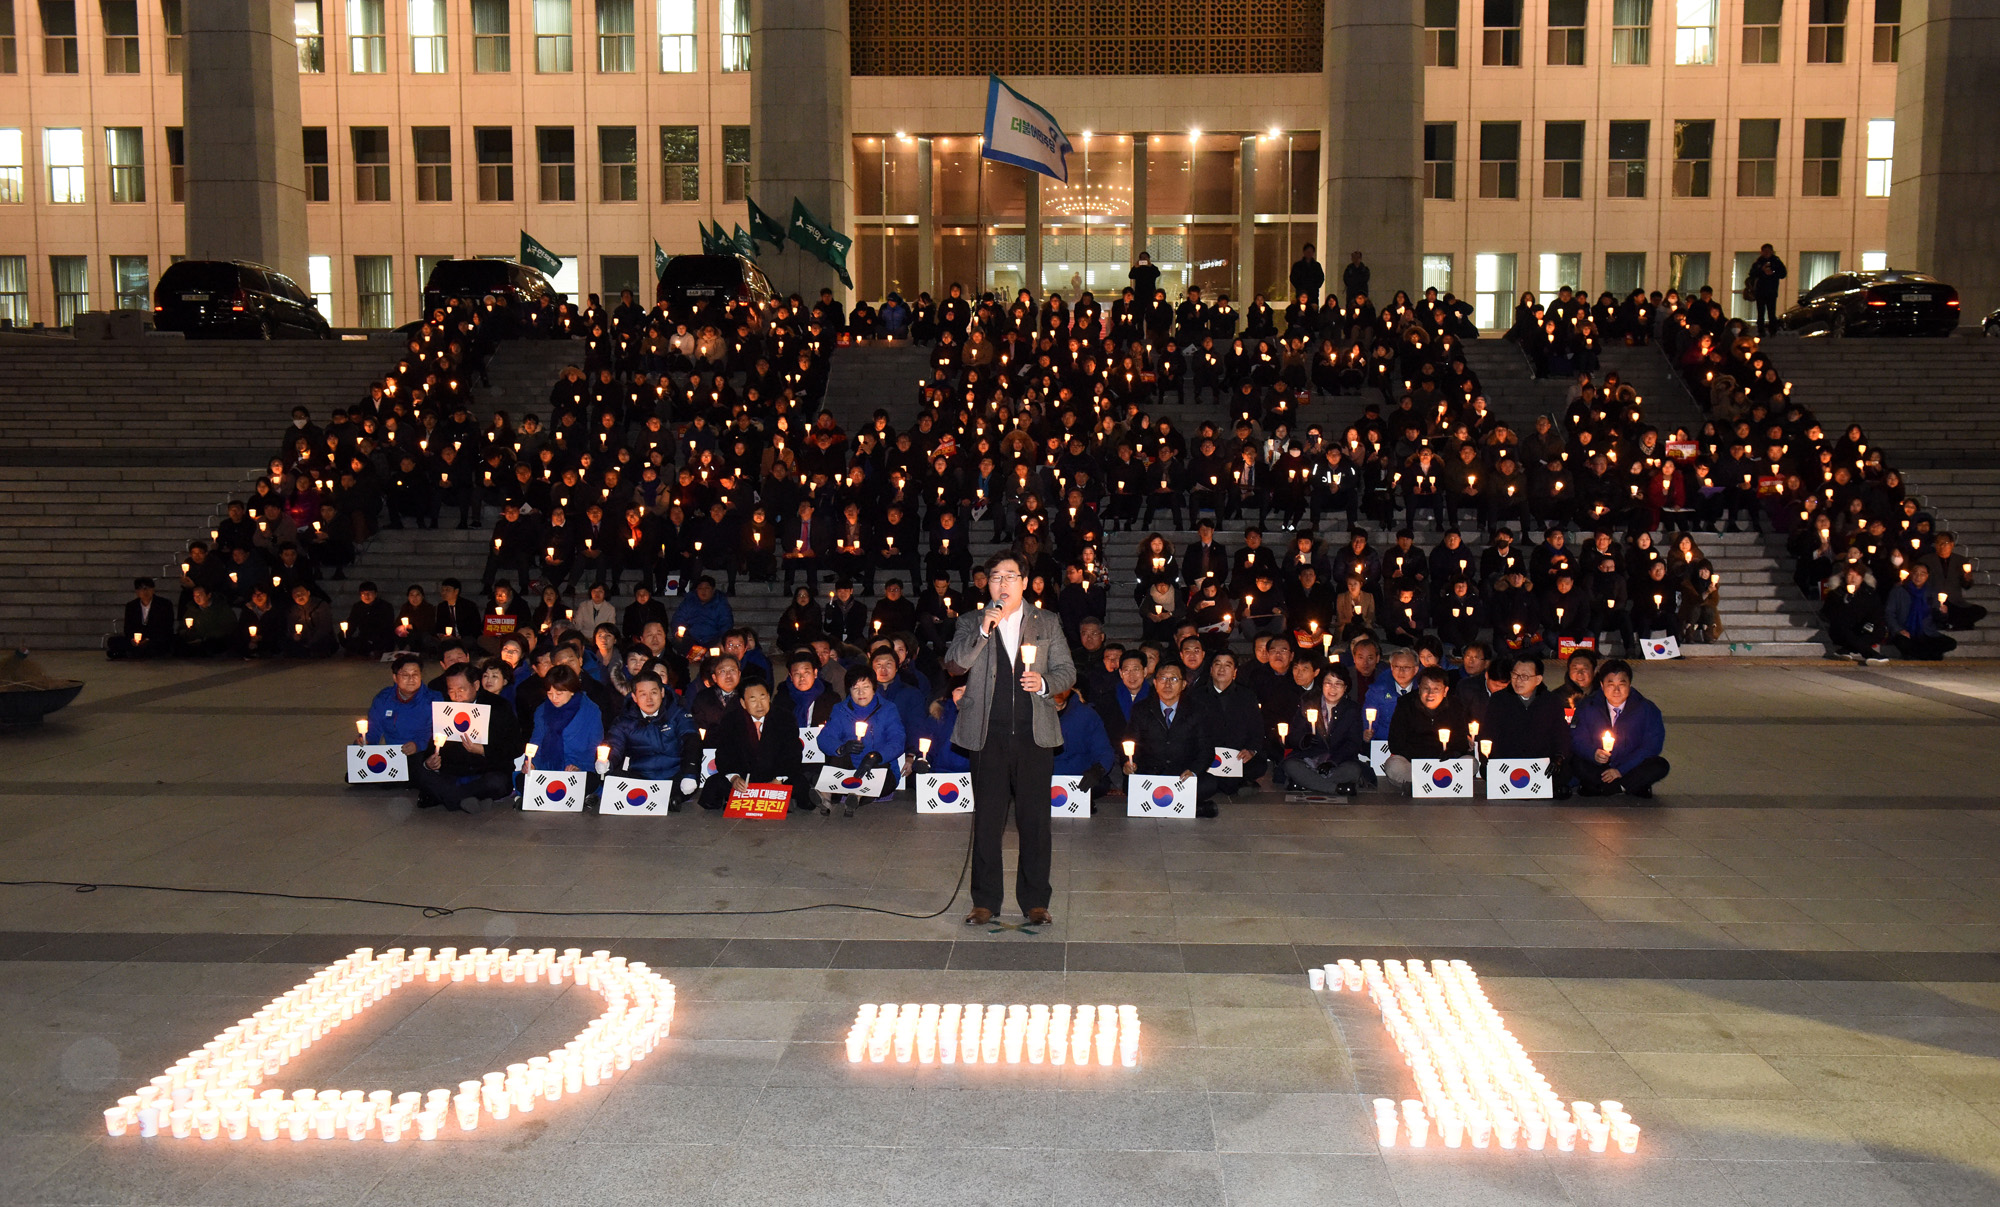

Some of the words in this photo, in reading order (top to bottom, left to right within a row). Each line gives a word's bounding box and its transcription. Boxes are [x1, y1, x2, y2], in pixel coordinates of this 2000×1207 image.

[1010, 116, 1056, 154] 더불어민주당
[760, 788, 788, 801] 대통령
[729, 799, 755, 811] 즉각
